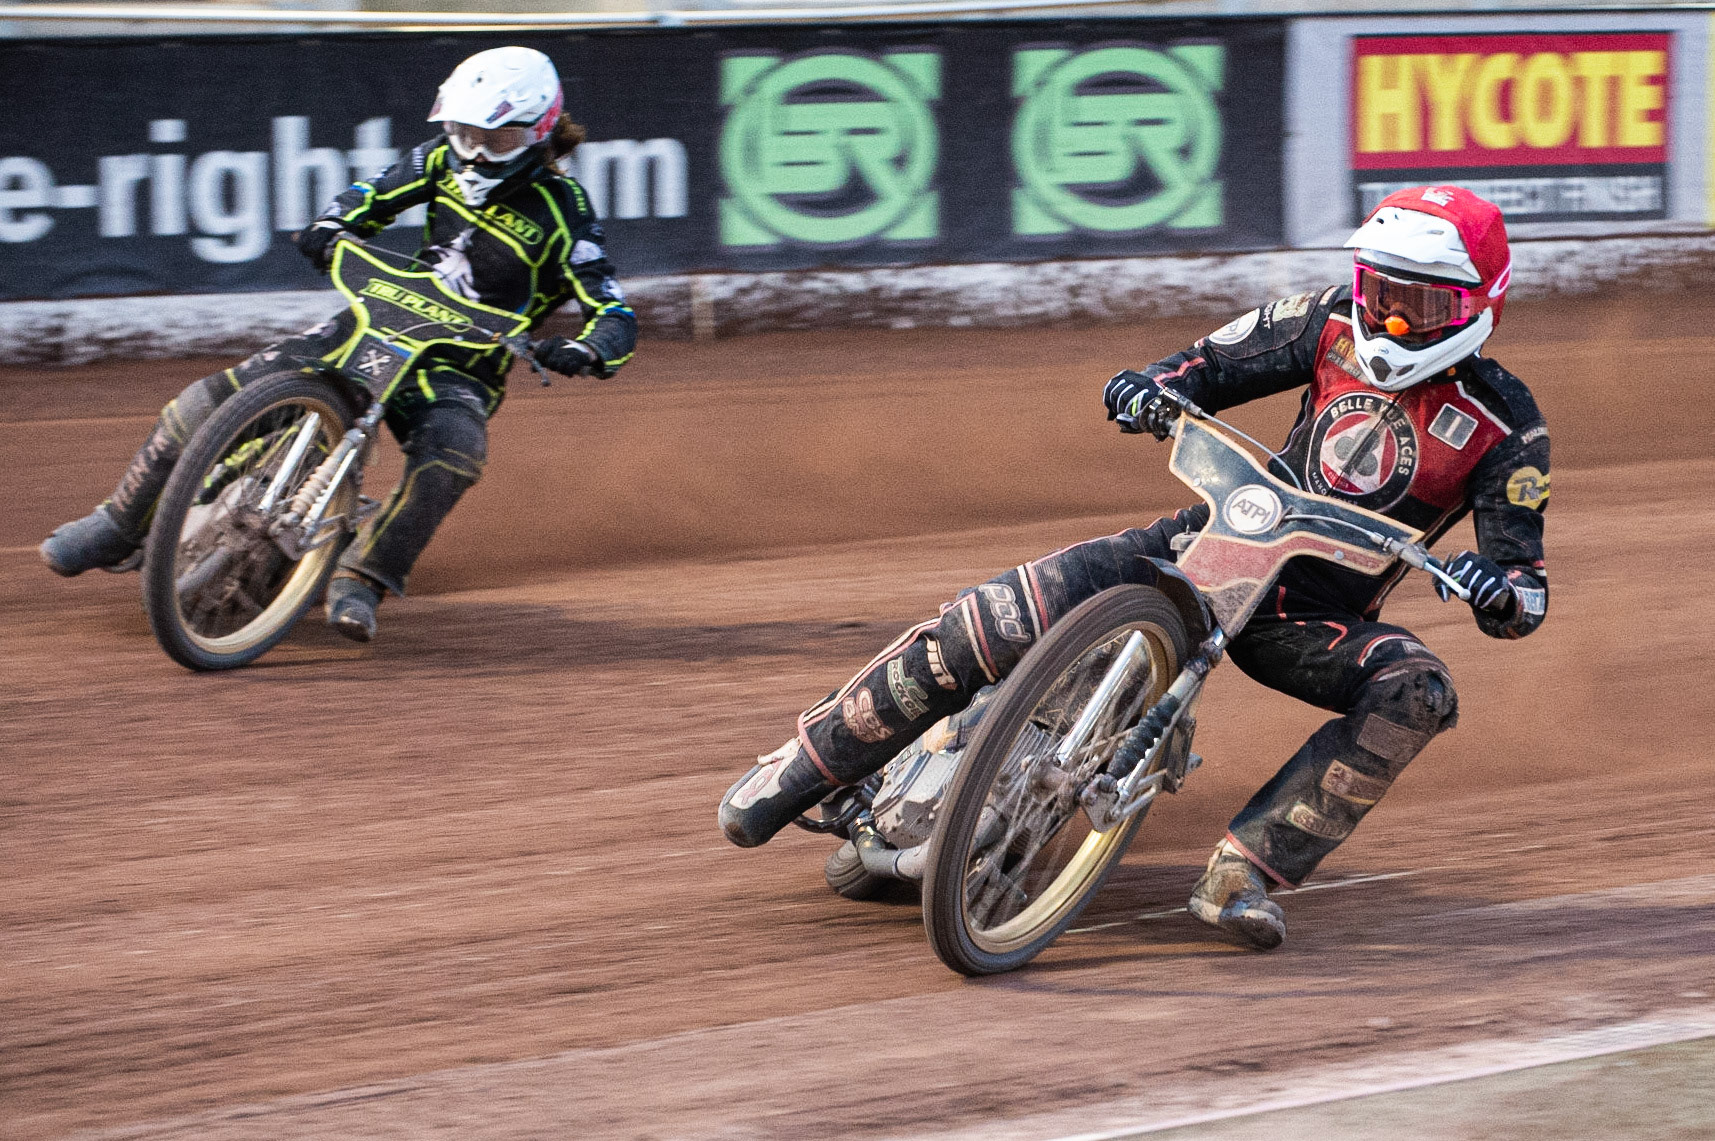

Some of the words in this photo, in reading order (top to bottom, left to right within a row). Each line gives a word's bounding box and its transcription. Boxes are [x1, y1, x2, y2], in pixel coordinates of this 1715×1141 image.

[1357, 50, 1667, 153] HYCOTE
[1330, 397, 1375, 419] BELLE
[1397, 436, 1414, 477] ACES
[1231, 498, 1271, 525] ATPI
